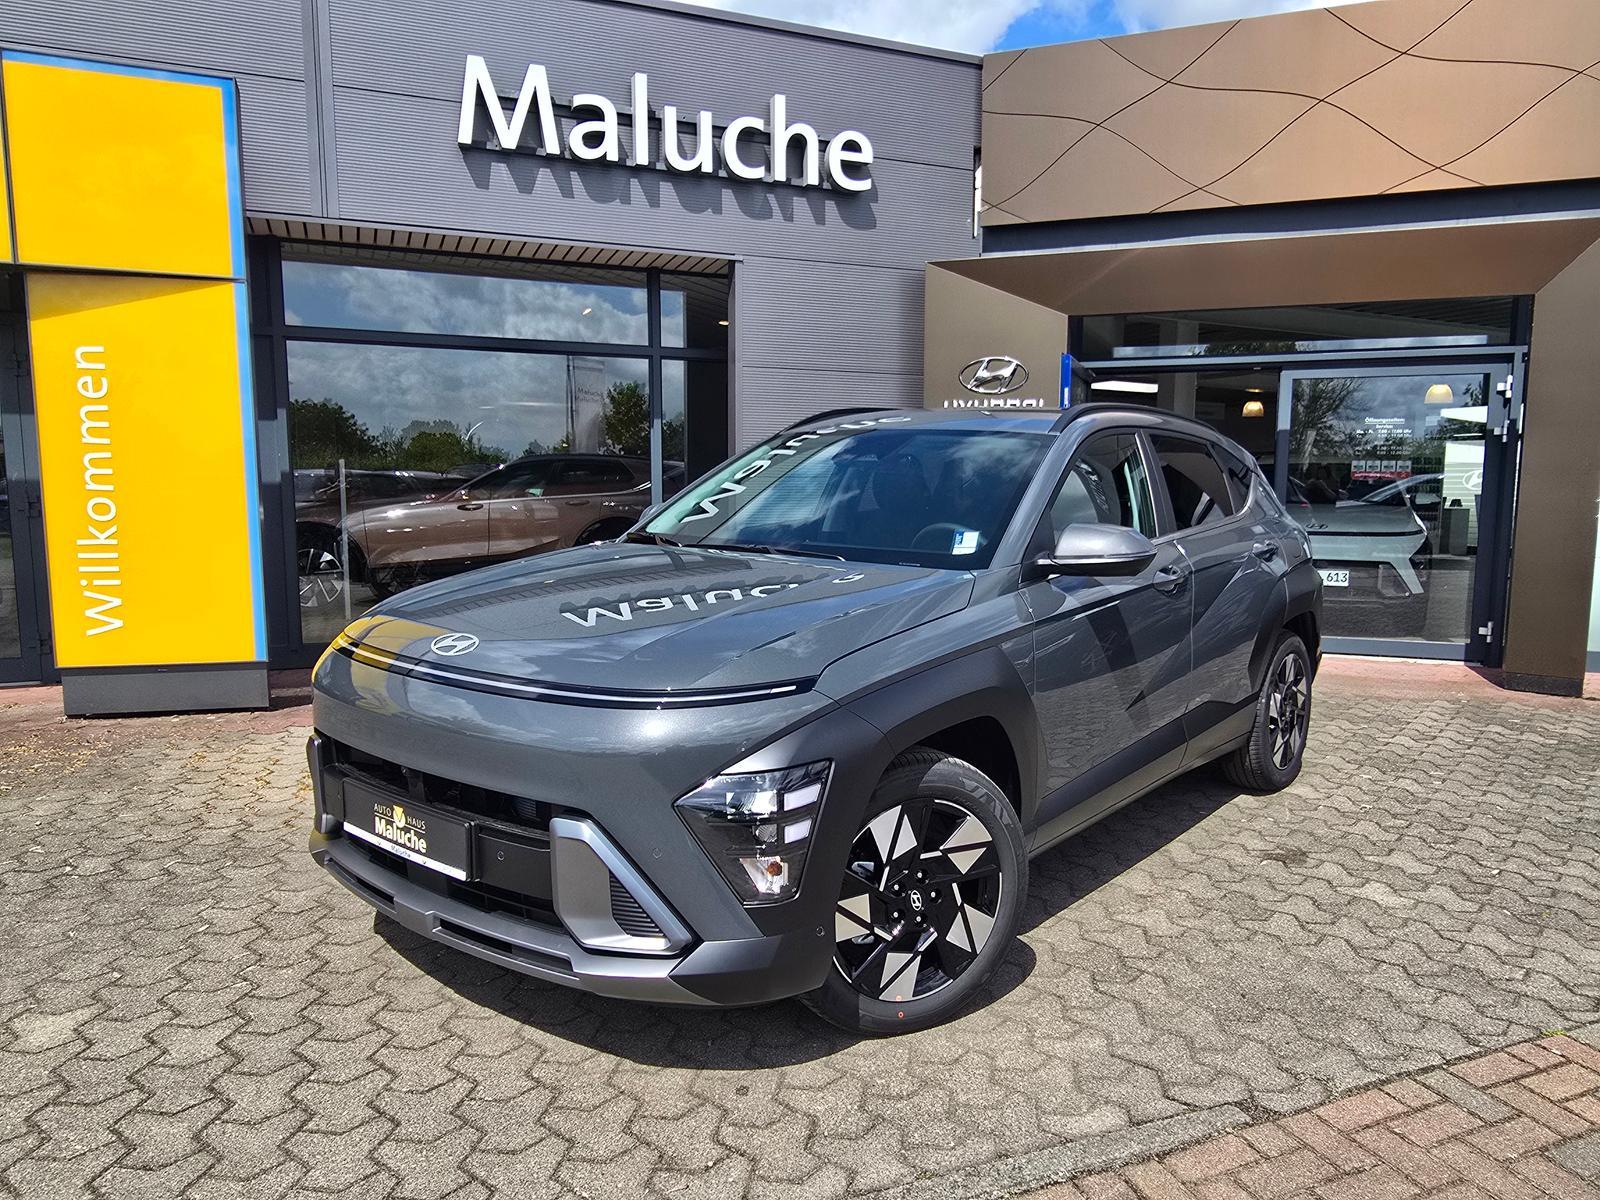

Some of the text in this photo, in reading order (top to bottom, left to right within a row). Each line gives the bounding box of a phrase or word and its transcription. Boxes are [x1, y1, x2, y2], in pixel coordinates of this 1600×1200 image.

[457, 54, 875, 194] Maluche
[74, 344, 124, 637] Willkommen
[1326, 572, 1348, 583] 613
[374, 803, 426, 830] AUTO HAUS
[374, 817, 427, 853] Maluche
